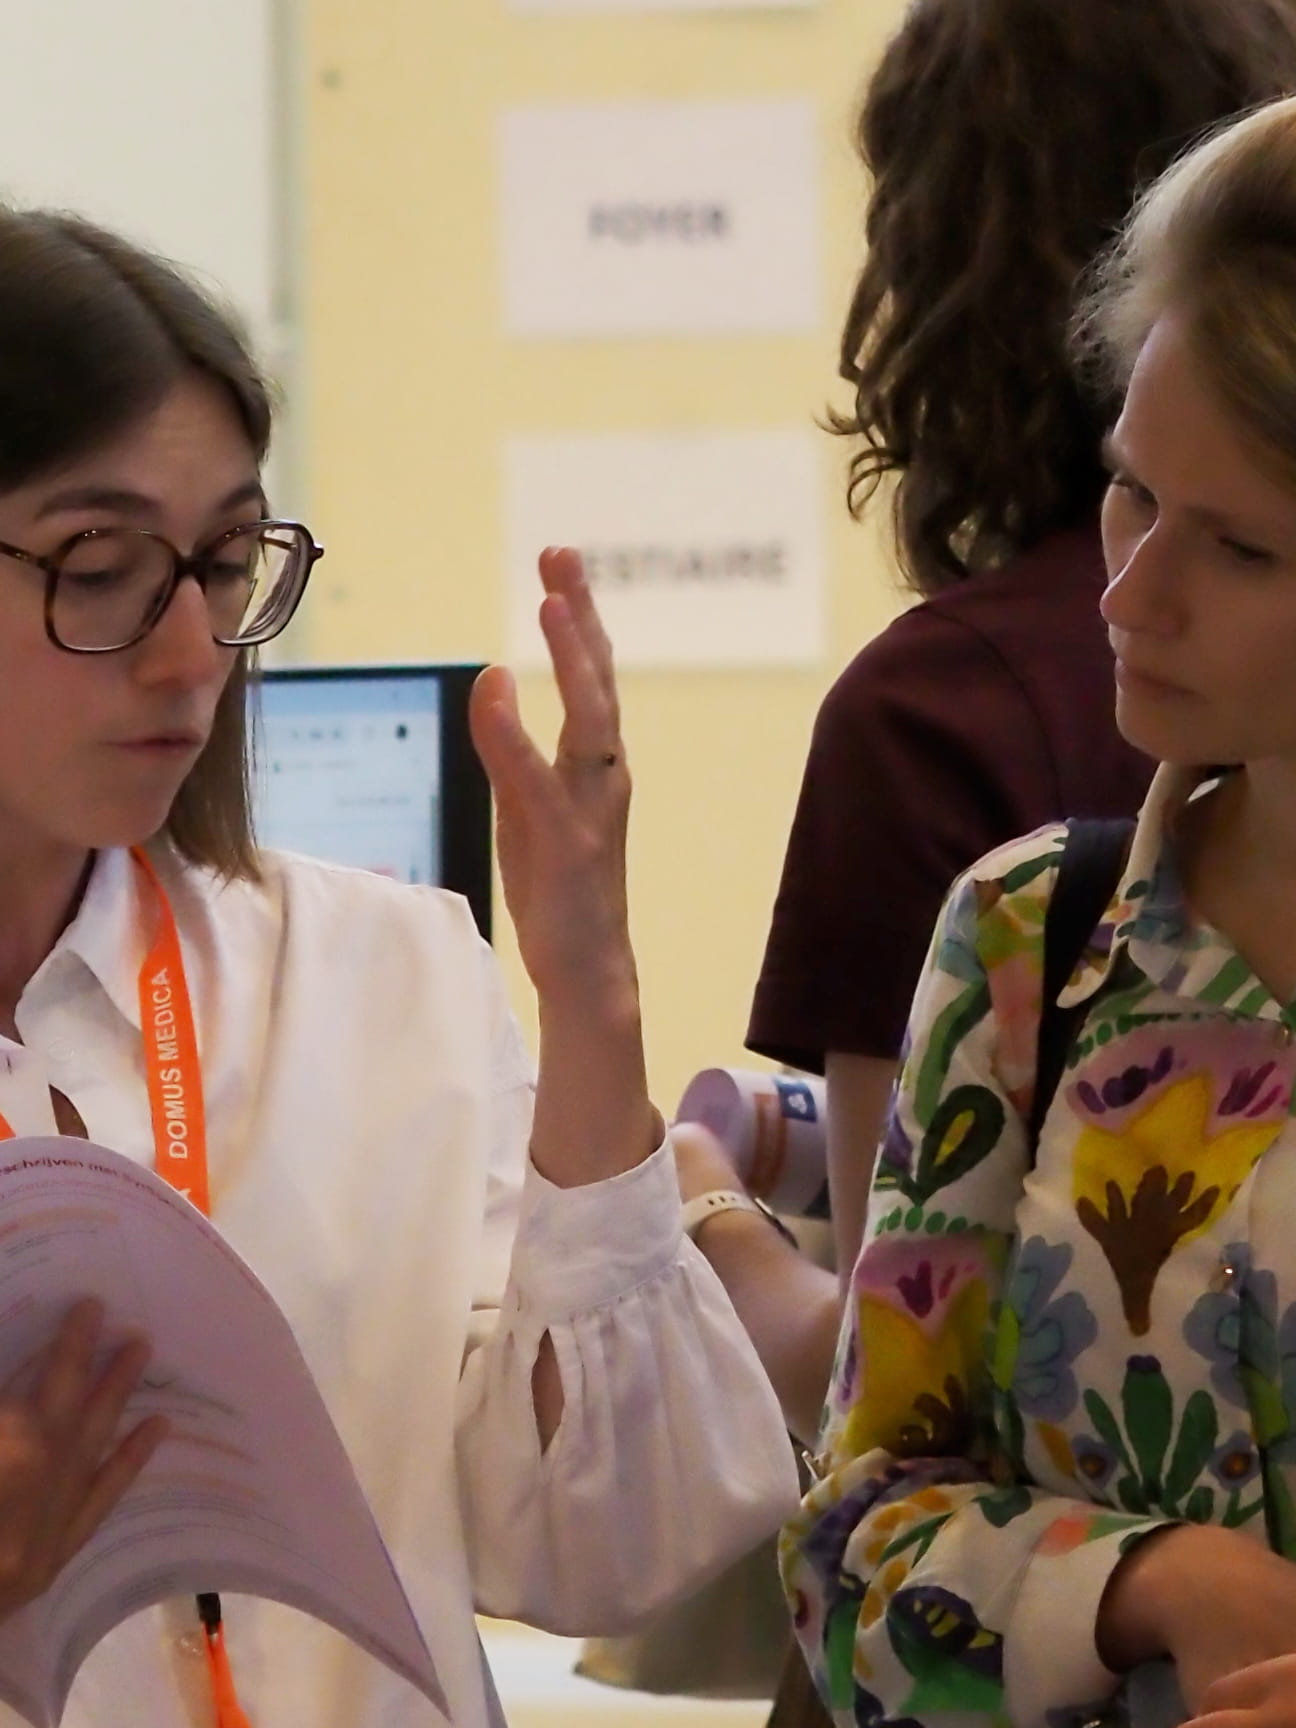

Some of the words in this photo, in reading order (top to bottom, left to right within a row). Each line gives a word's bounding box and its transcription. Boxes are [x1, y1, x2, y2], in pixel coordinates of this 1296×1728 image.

[590, 203, 730, 245] FOYER
[582, 540, 788, 588] ESTIAIRE
[151, 969, 179, 1060] MEDICA
[160, 1068, 188, 1160] DOMUS
